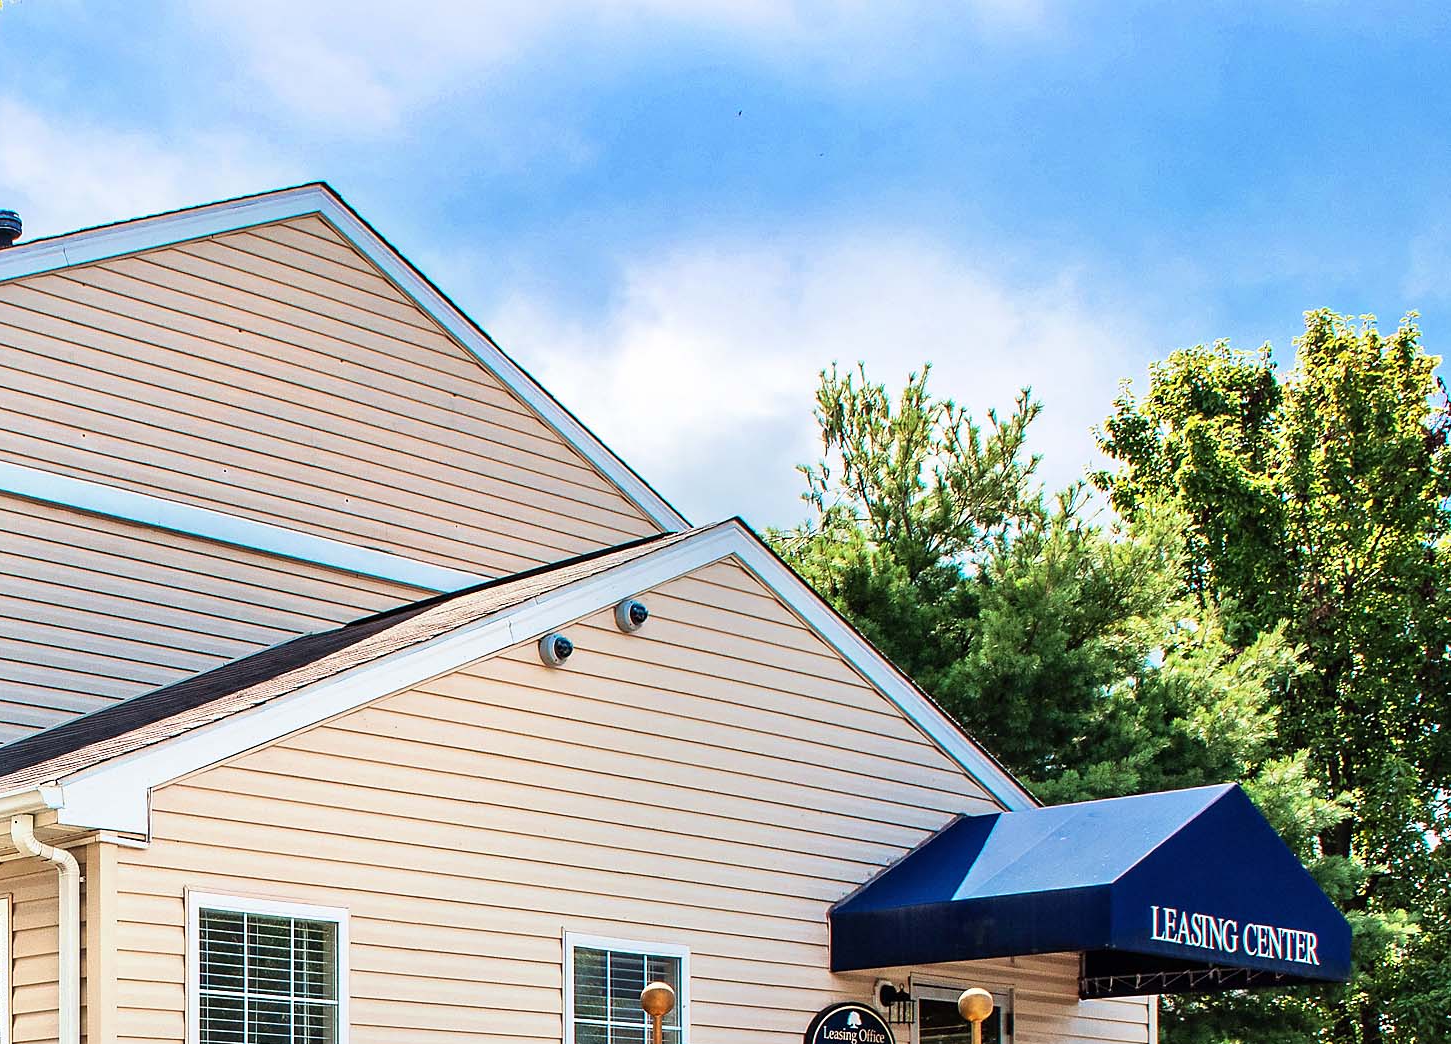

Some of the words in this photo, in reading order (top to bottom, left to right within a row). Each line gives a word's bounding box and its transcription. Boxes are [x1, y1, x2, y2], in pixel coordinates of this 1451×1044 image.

[1150, 905, 1239, 953] LEASING
[1243, 923, 1320, 966] CENTER
[859, 1028, 886, 1044] Office
